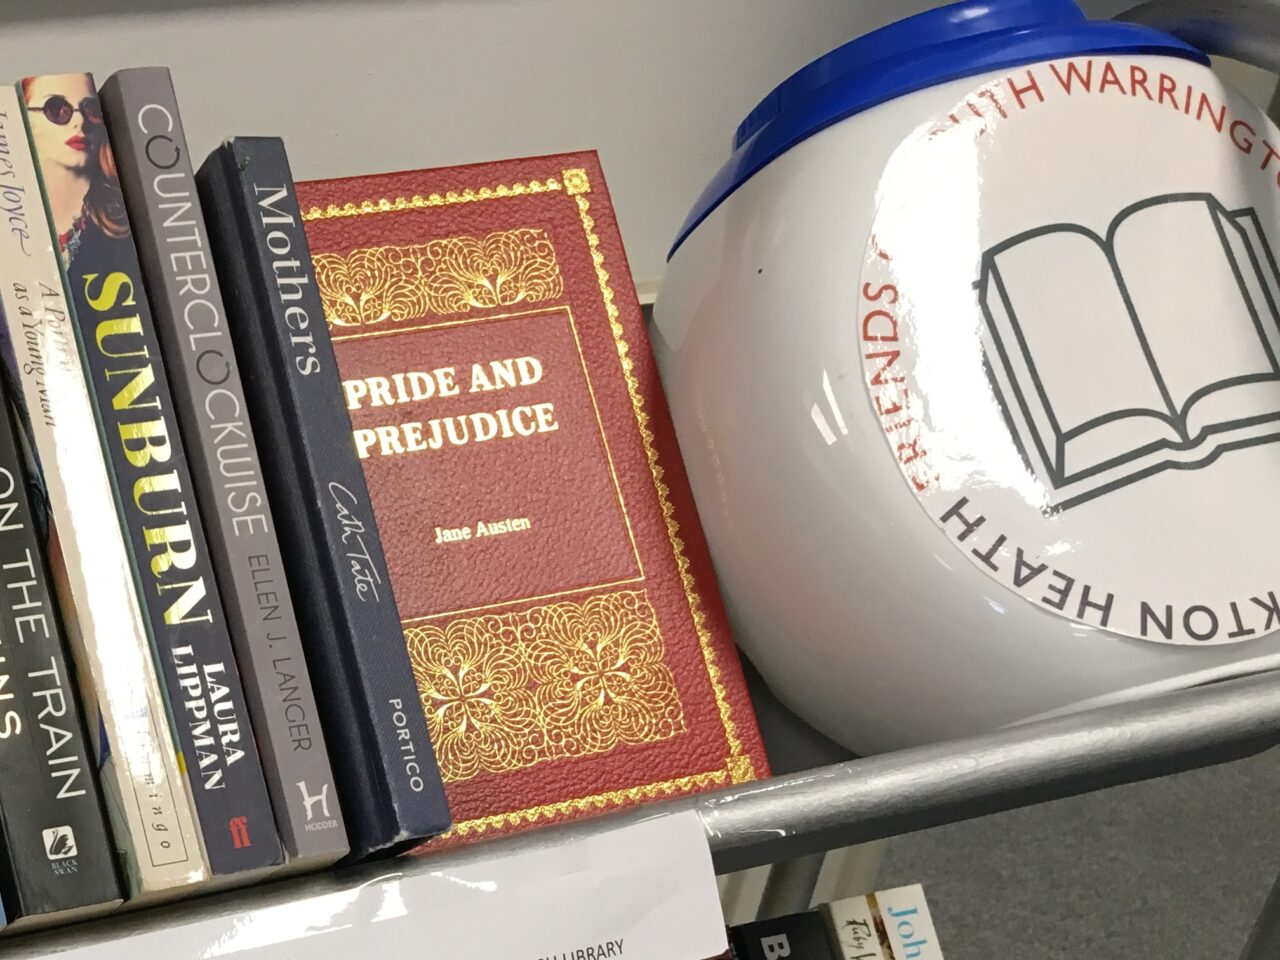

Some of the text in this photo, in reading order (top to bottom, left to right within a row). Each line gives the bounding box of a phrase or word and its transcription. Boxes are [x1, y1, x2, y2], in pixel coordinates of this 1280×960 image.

[1050, 59, 1280, 189] WARRINGT
[13, 282, 29, 301] as
[82, 271, 213, 625] SUNBURN
[138, 104, 313, 752] COUNTERCLOCKWISE ELLEN J. LANGER
[342, 356, 543, 410] PRIDE AND
[352, 403, 559, 459] PREJUDICE
[253, 183, 424, 793] Mothers Cath Tate PORTICO
[434, 517, 531, 544] Jane Austen
[939, 496, 1115, 628] HEATH
[2, 548, 50, 643] THE
[28, 656, 86, 800] TRAIN
[171, 645, 226, 790] LIPPMAN
[202, 661, 246, 767] LAURA
[304, 819, 338, 832] HODDER
